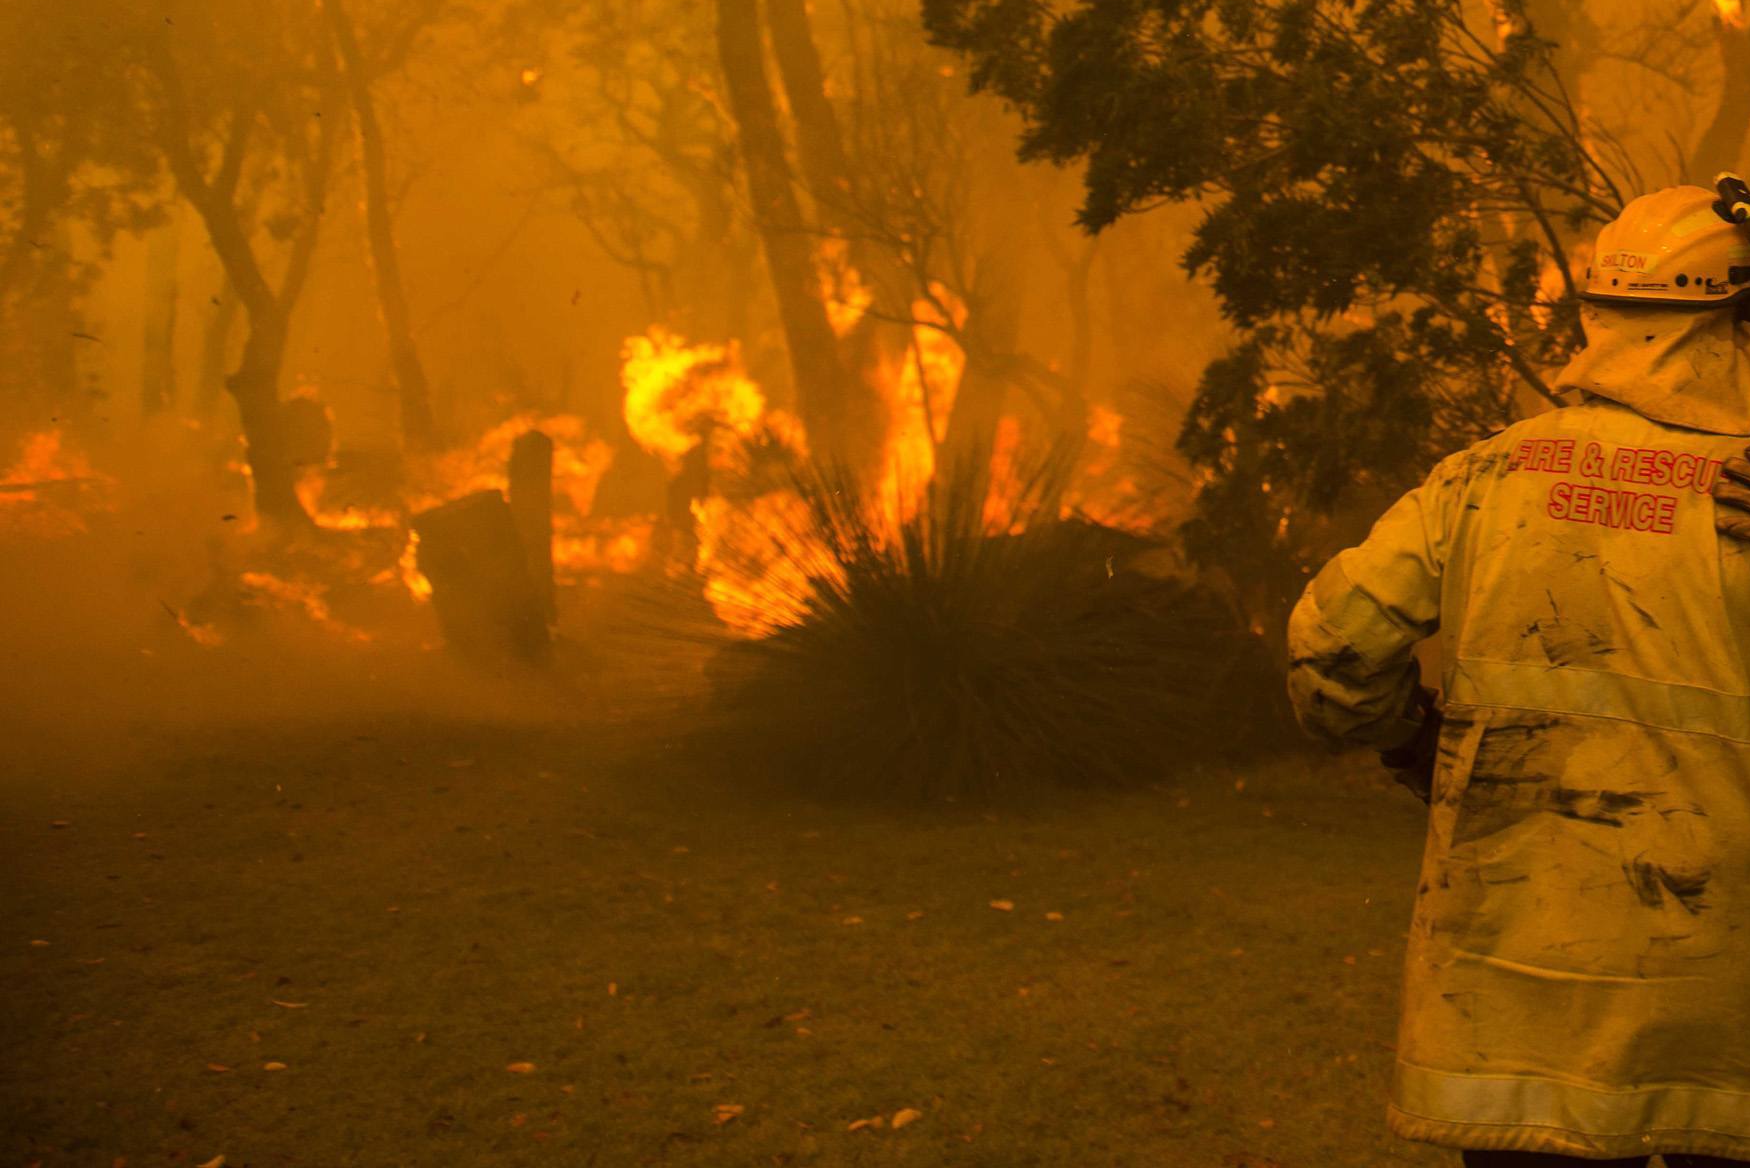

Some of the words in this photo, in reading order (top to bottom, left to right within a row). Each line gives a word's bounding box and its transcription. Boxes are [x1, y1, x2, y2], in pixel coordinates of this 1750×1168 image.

[1507, 438, 1575, 473] FIRE
[1580, 441, 1606, 478] &
[1547, 482, 1678, 534] SERVICE
